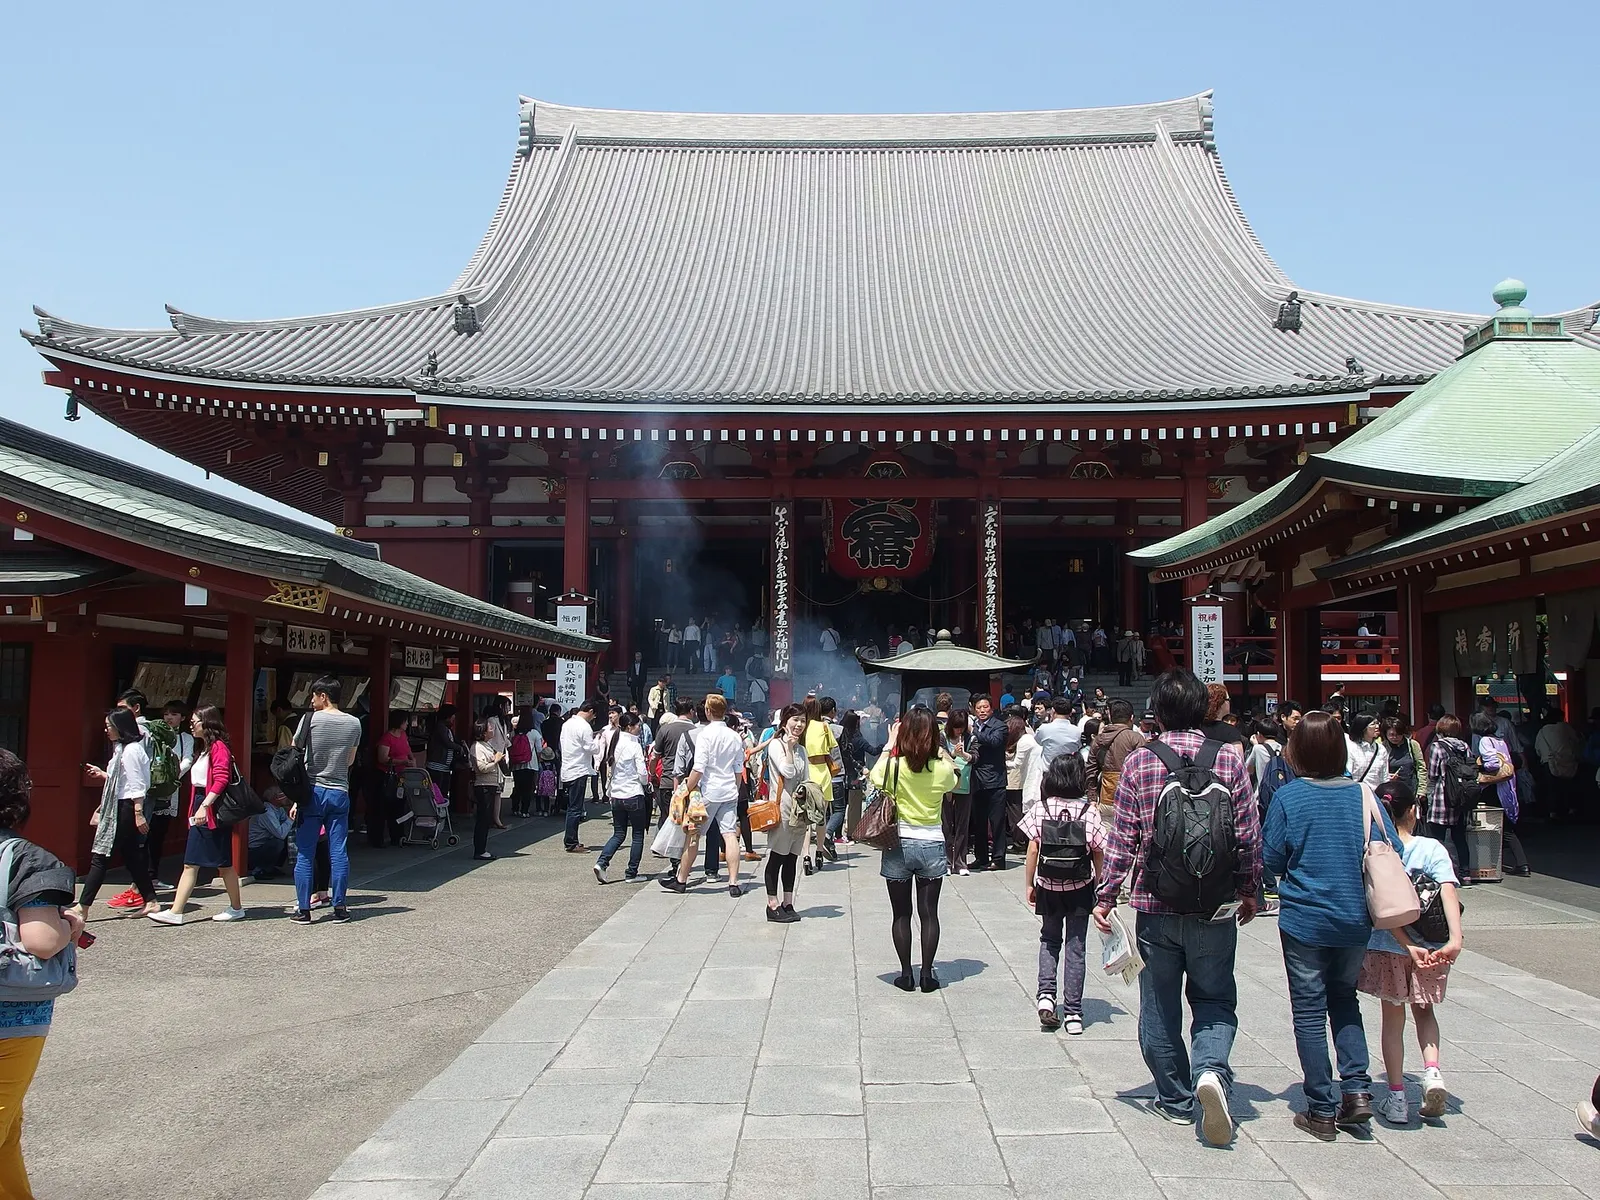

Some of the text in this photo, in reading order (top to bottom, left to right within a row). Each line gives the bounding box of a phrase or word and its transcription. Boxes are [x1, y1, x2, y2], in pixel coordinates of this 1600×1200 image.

[288, 628, 327, 652] お札お守
[406, 651, 431, 667] お札お守
[1202, 624, 1216, 683] 十三まいりお加
